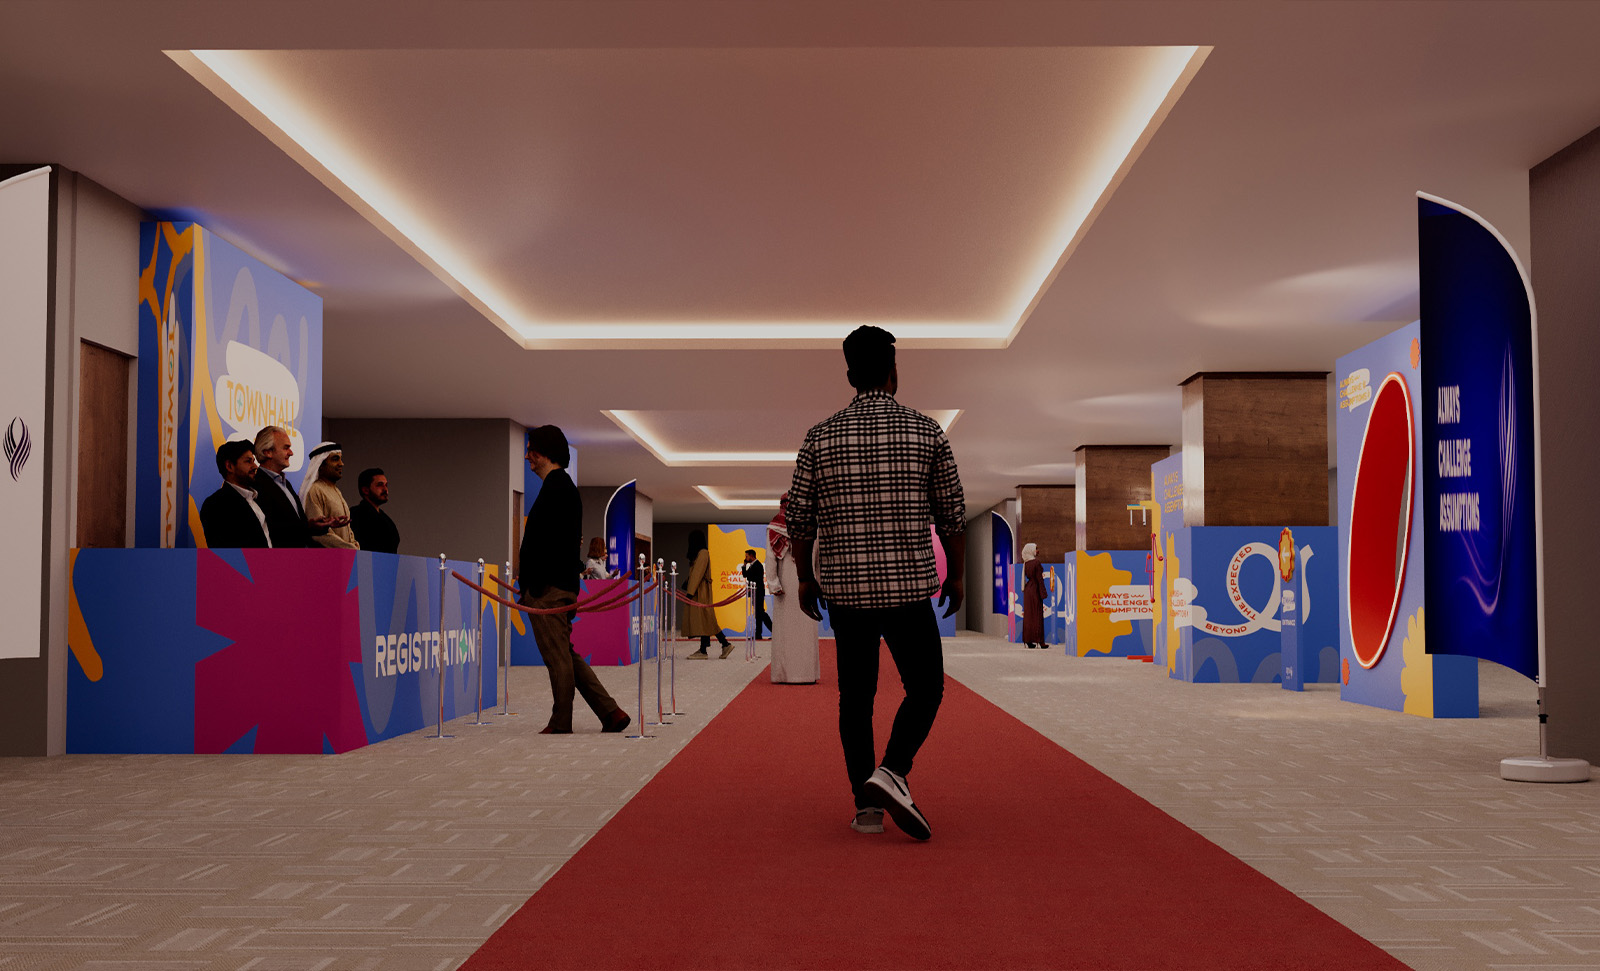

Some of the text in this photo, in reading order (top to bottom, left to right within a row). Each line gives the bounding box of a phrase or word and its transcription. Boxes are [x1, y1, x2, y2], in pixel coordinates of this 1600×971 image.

[226, 380, 297, 438] TOWNHALL
[1437, 384, 1460, 424] ALWAYS
[165, 325, 175, 549] TOWNHAL
[1438, 437, 1471, 478] CHALLENGE
[1439, 491, 1480, 532] ASSUMPTIONS
[1205, 546, 1257, 635] BEYOND THE EXPECTED
[375, 628, 475, 678] REGISTRATION
